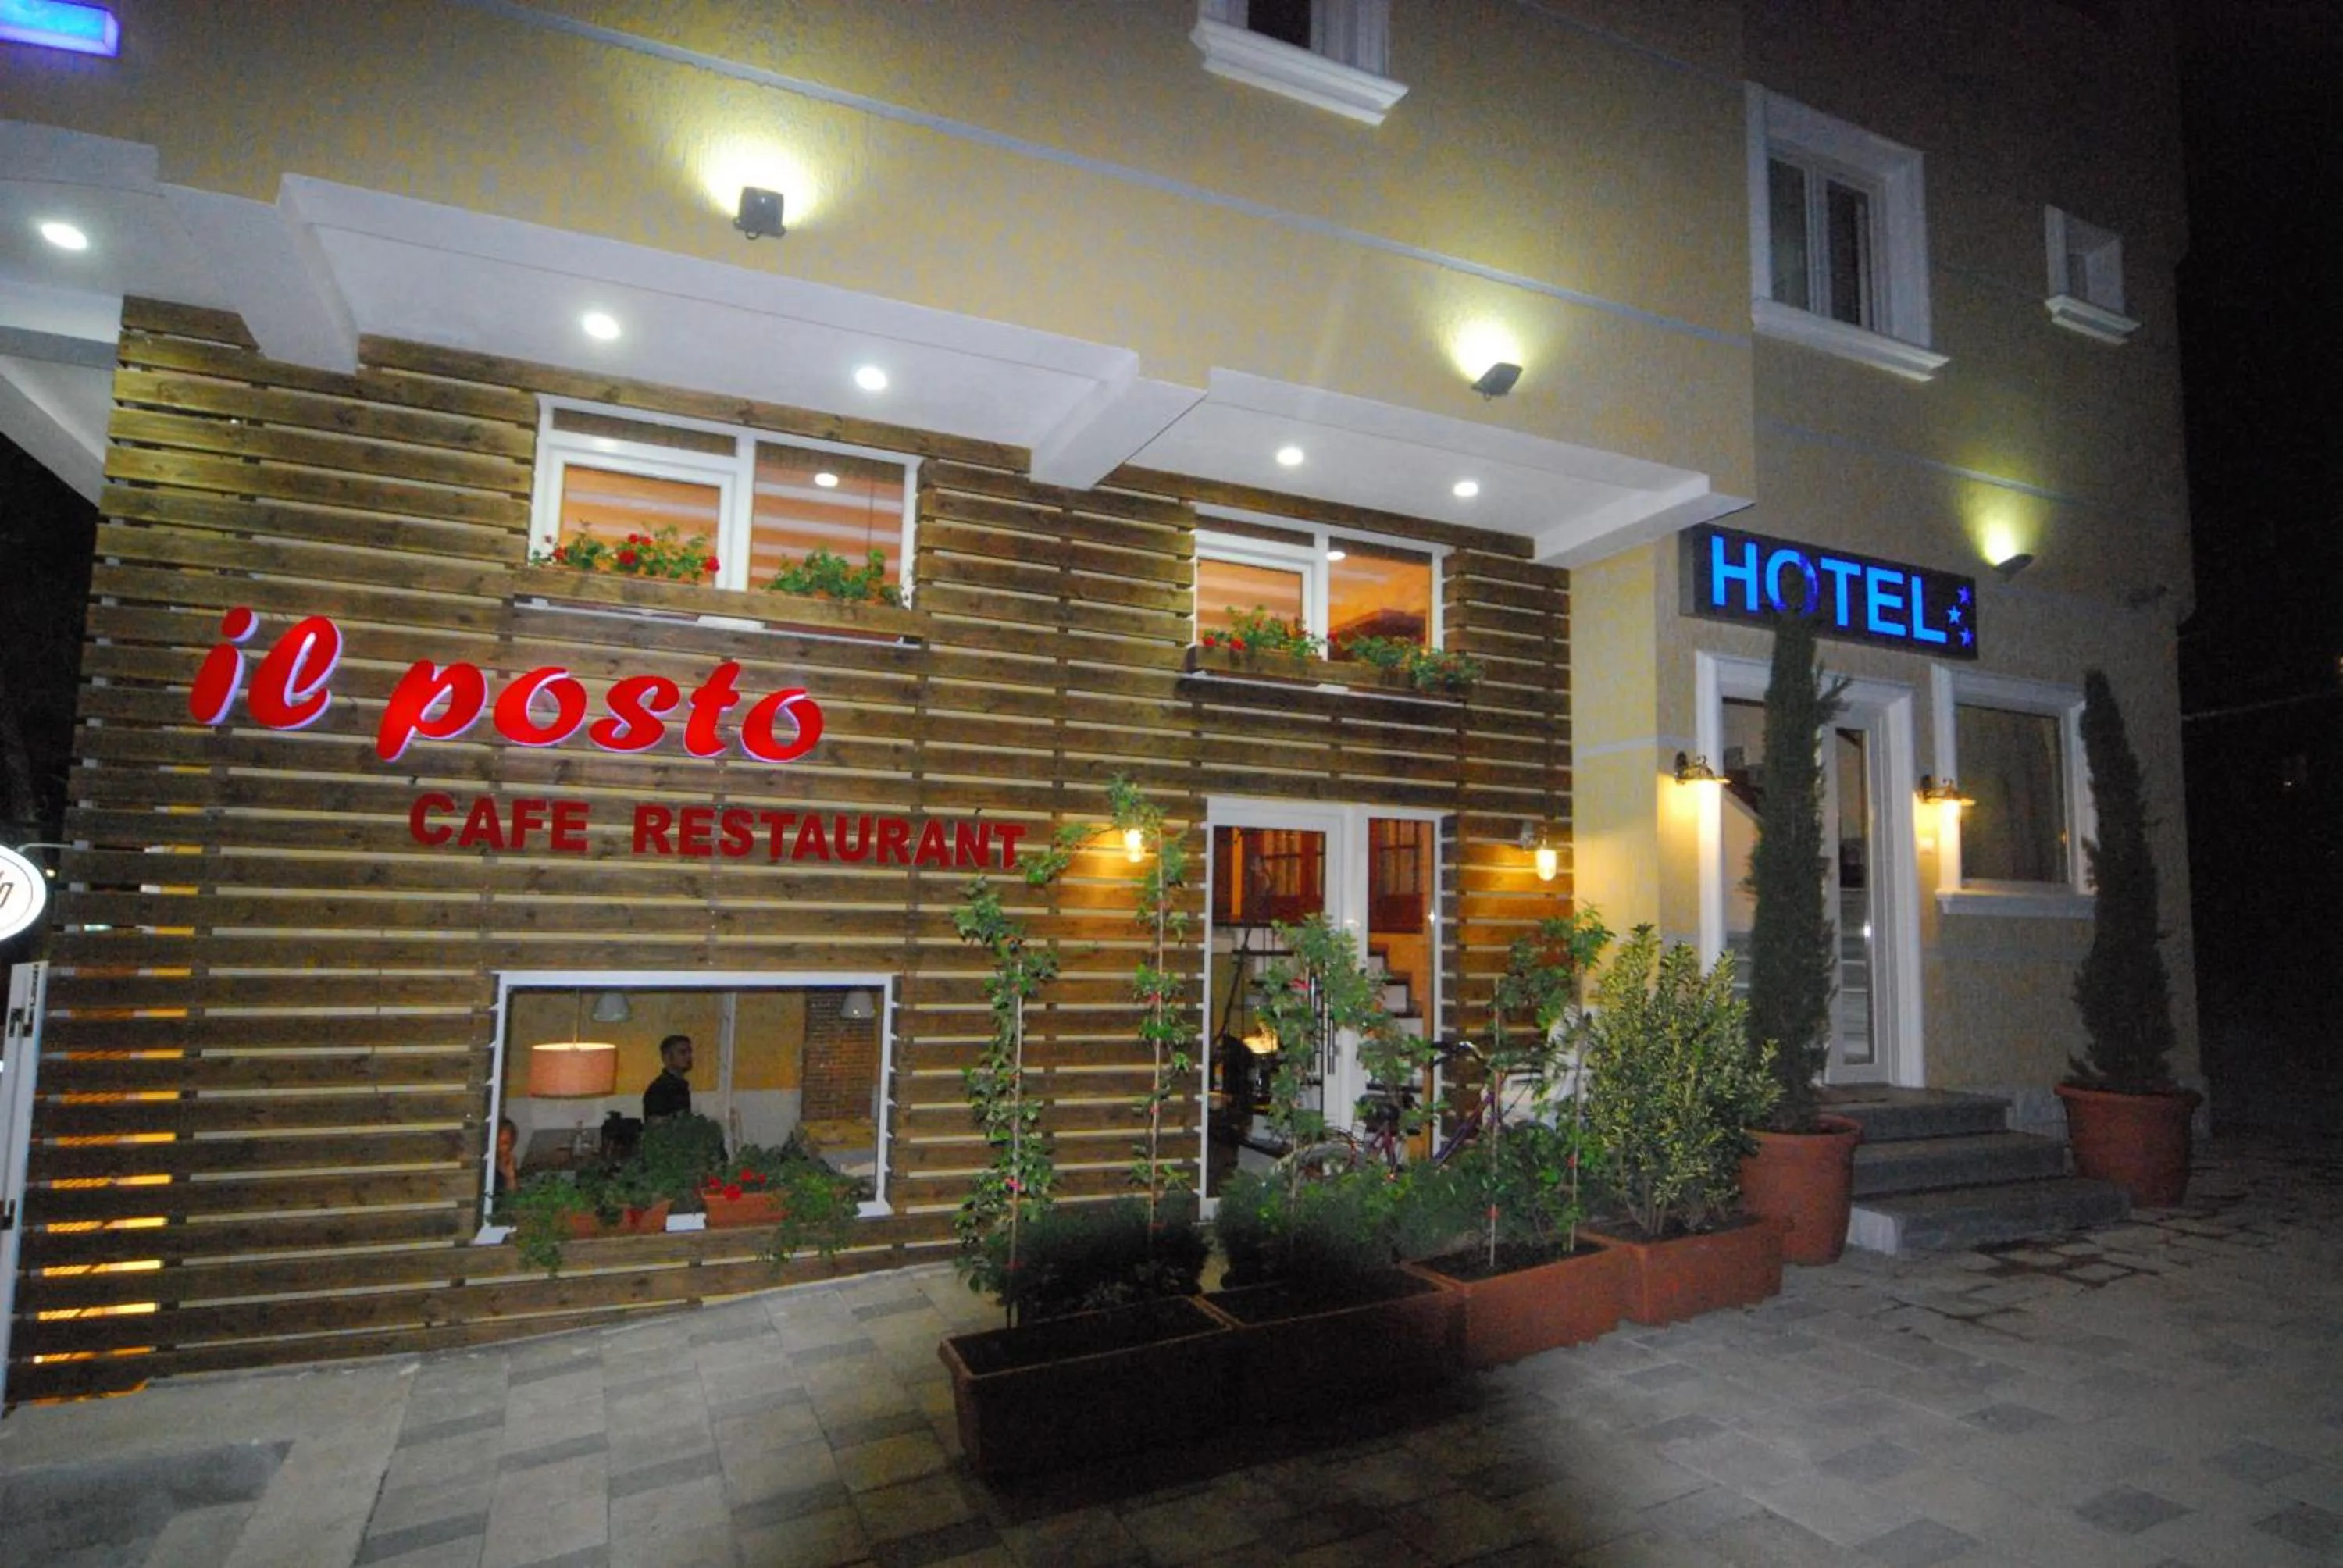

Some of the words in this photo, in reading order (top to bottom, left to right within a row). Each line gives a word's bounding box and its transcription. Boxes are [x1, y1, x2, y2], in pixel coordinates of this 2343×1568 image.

[1711, 536, 1946, 643] HOTEL
[189, 606, 342, 729] il
[376, 660, 825, 762] posto
[409, 792, 591, 853] CAFE
[631, 804, 1026, 869] RESTAURANT
